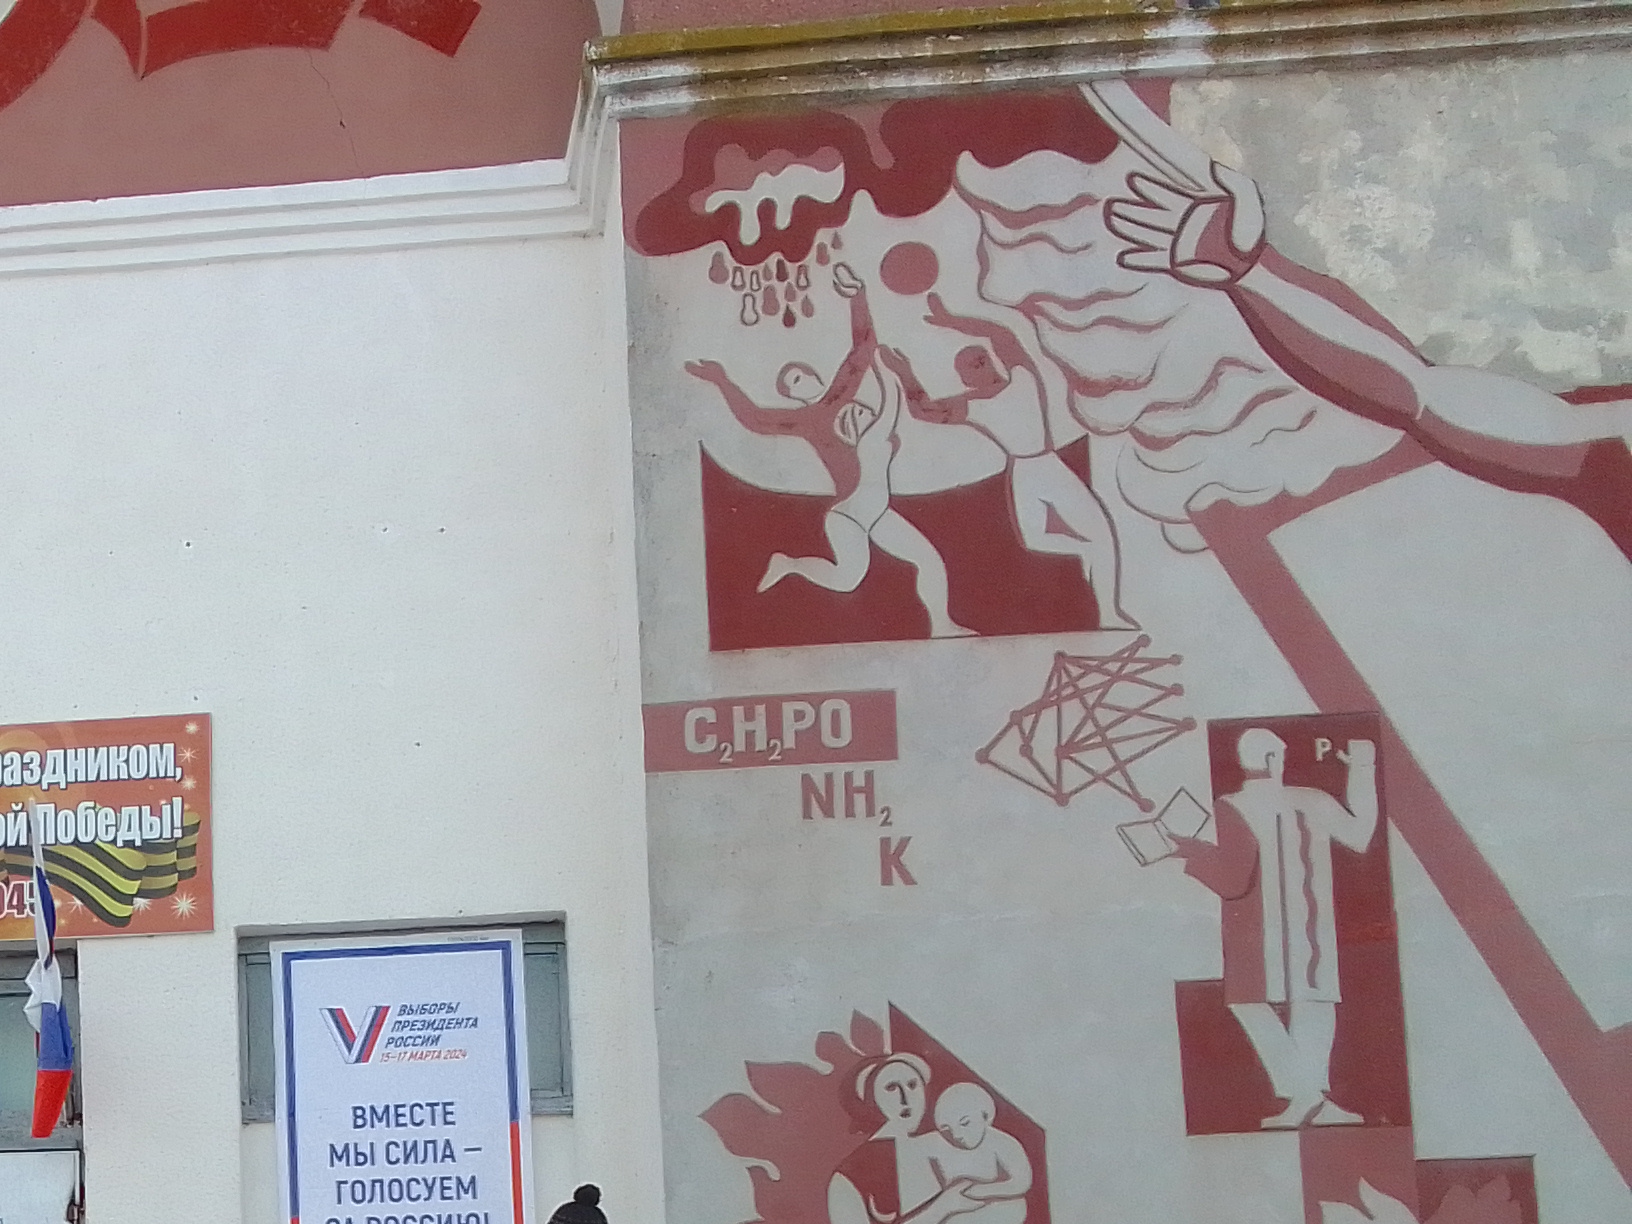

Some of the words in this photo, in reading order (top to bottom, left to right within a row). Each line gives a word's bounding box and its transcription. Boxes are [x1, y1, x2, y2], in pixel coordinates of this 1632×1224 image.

[35, 796, 184, 848] Победы!
[878, 835, 918, 886] K
[397, 1001, 461, 1017] ВЫБОРЫ
[390, 1017, 479, 1033] ПРЕЗИДЕНТА
[384, 1034, 442, 1049] РОССИИ
[407, 1050, 442, 1062] МАРТА
[443, 1049, 468, 1061] 2024
[351, 1101, 456, 1129] ВМЕСТЕ
[328, 1141, 376, 1168] МЫ
[384, 1138, 457, 1166] СИЛА
[335, 1175, 478, 1206] ГОЛОСУЕМ
